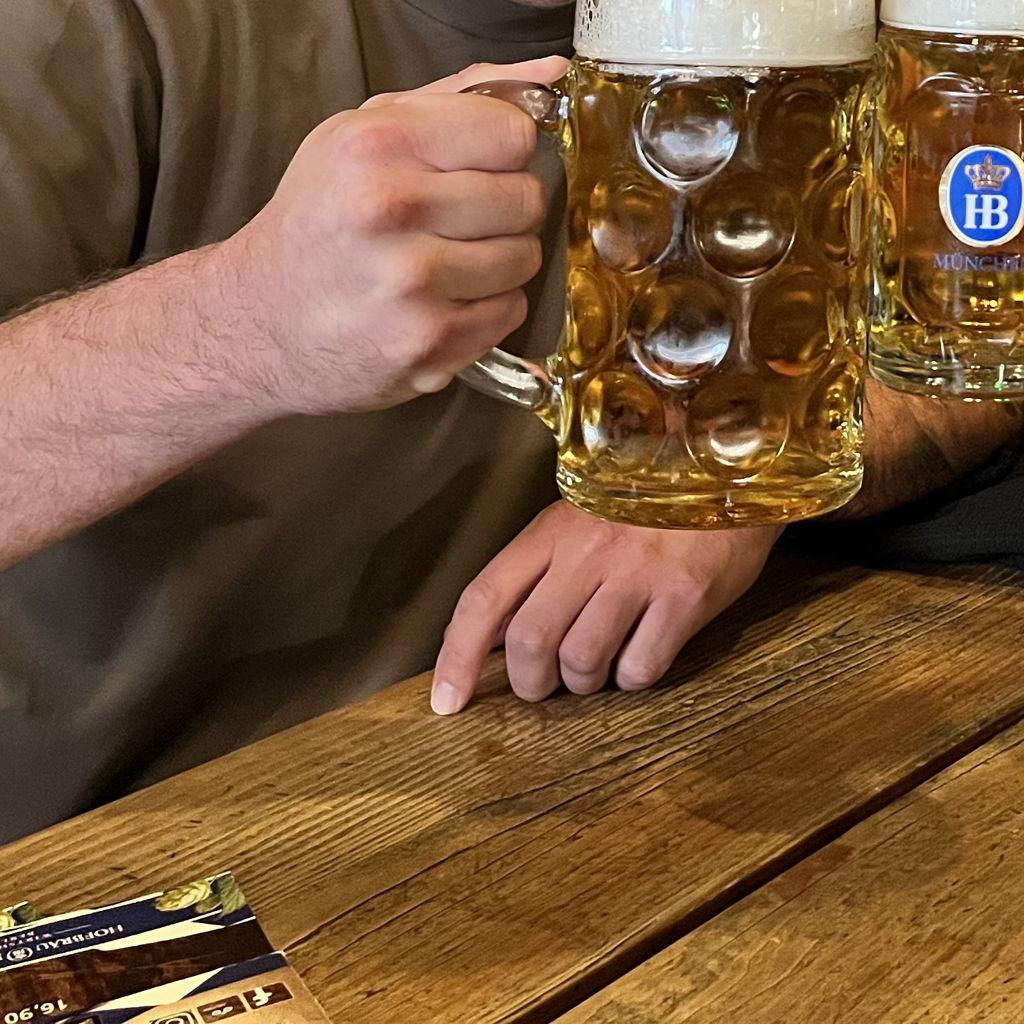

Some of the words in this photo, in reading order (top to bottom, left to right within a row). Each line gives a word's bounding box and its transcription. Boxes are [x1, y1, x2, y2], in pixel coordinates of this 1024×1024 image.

[963, 193, 1009, 230] HB
[36, 924, 124, 951] HOFBRÄU
[4, 999, 68, 1024] 16,90
